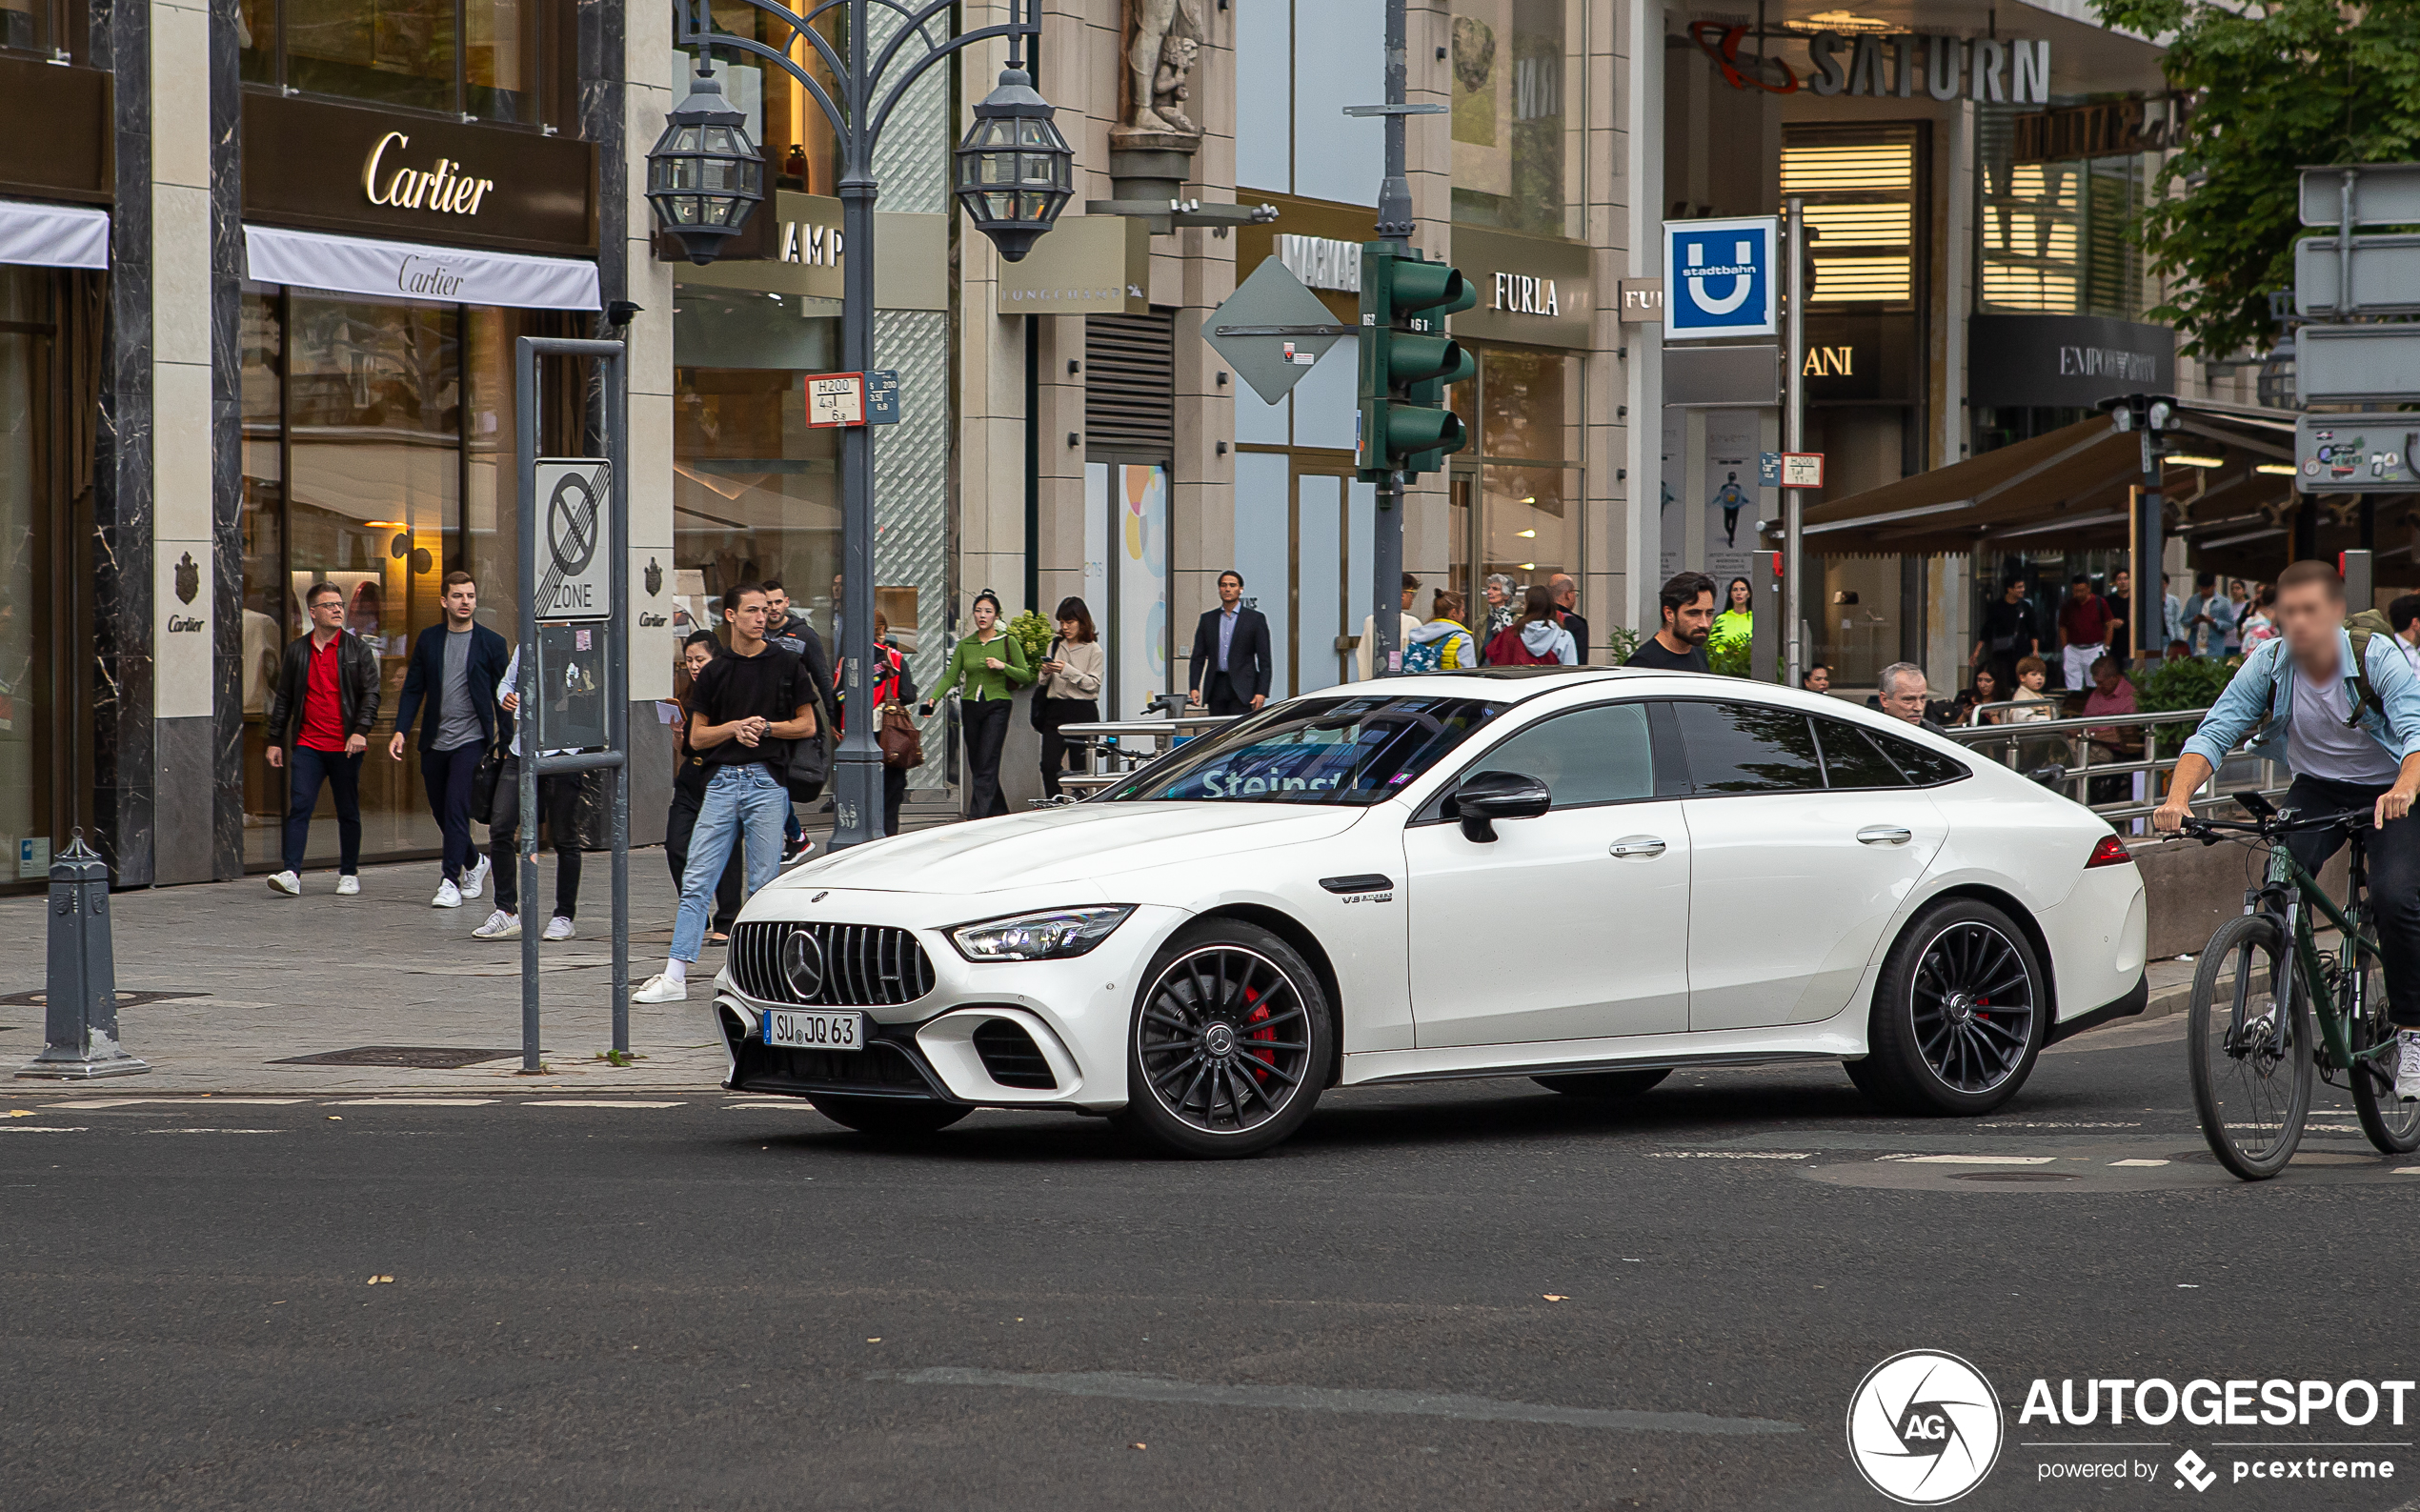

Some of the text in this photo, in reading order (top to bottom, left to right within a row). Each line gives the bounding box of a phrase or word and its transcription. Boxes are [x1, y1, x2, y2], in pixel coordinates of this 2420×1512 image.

[1811, 30, 2050, 104] SATURN
[365, 131, 494, 215] Cartier
[780, 221, 843, 267] AMP
[397, 253, 464, 296] Cartier
[1683, 266, 1757, 276] stadtbahn
[1495, 272, 1559, 316] FURLA
[1802, 346, 1852, 375] ANI
[818, 379, 849, 392] H200
[553, 584, 593, 608] ZONE
[168, 615, 205, 633] Cartier
[639, 611, 668, 627] Cartier
[776, 1015, 853, 1044] SU JQ 63
